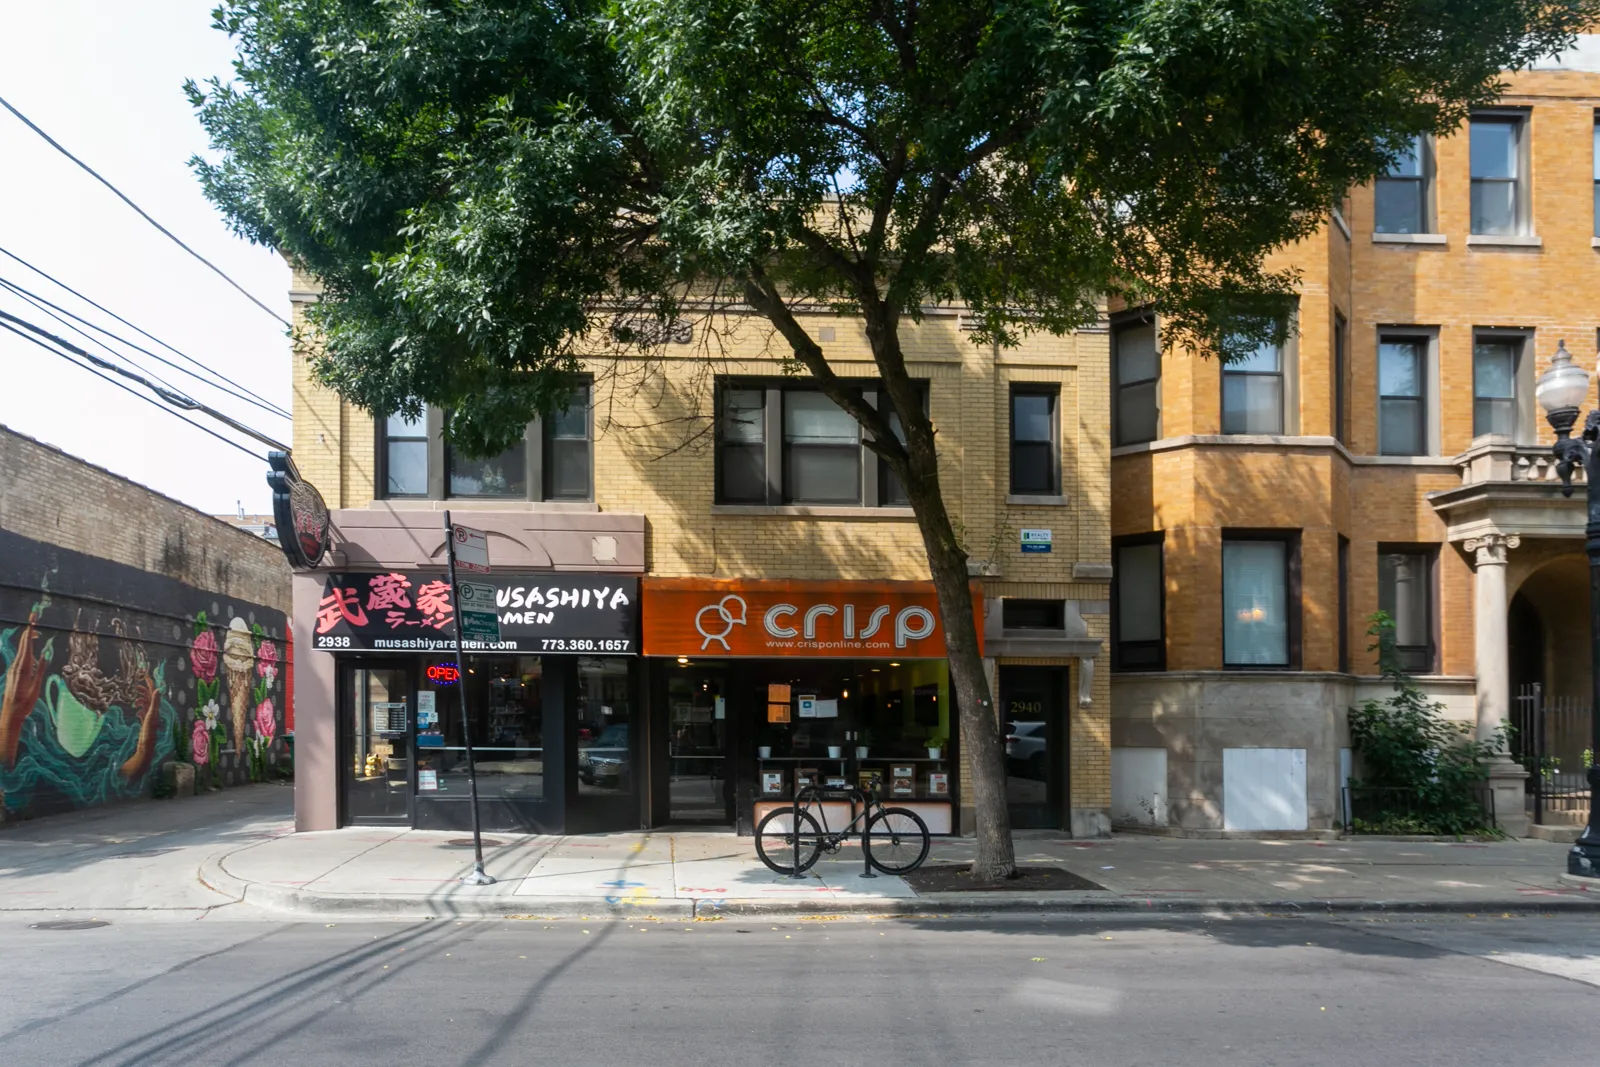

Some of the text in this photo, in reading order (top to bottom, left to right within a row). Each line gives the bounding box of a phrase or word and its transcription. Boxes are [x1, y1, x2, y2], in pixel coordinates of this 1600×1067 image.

[471, 563, 486, 572] ZONE
[496, 586, 629, 610] USASHIYA
[385, 611, 454, 629] ラーメン
[498, 611, 554, 625] MEN
[763, 604, 936, 648] crisp
[318, 637, 350, 648] 2938
[541, 639, 630, 650] 773.360.1657
[765, 639, 890, 649] www.crisponline.com
[427, 666, 460, 681] OPEN
[1011, 701, 1042, 717] 2940
